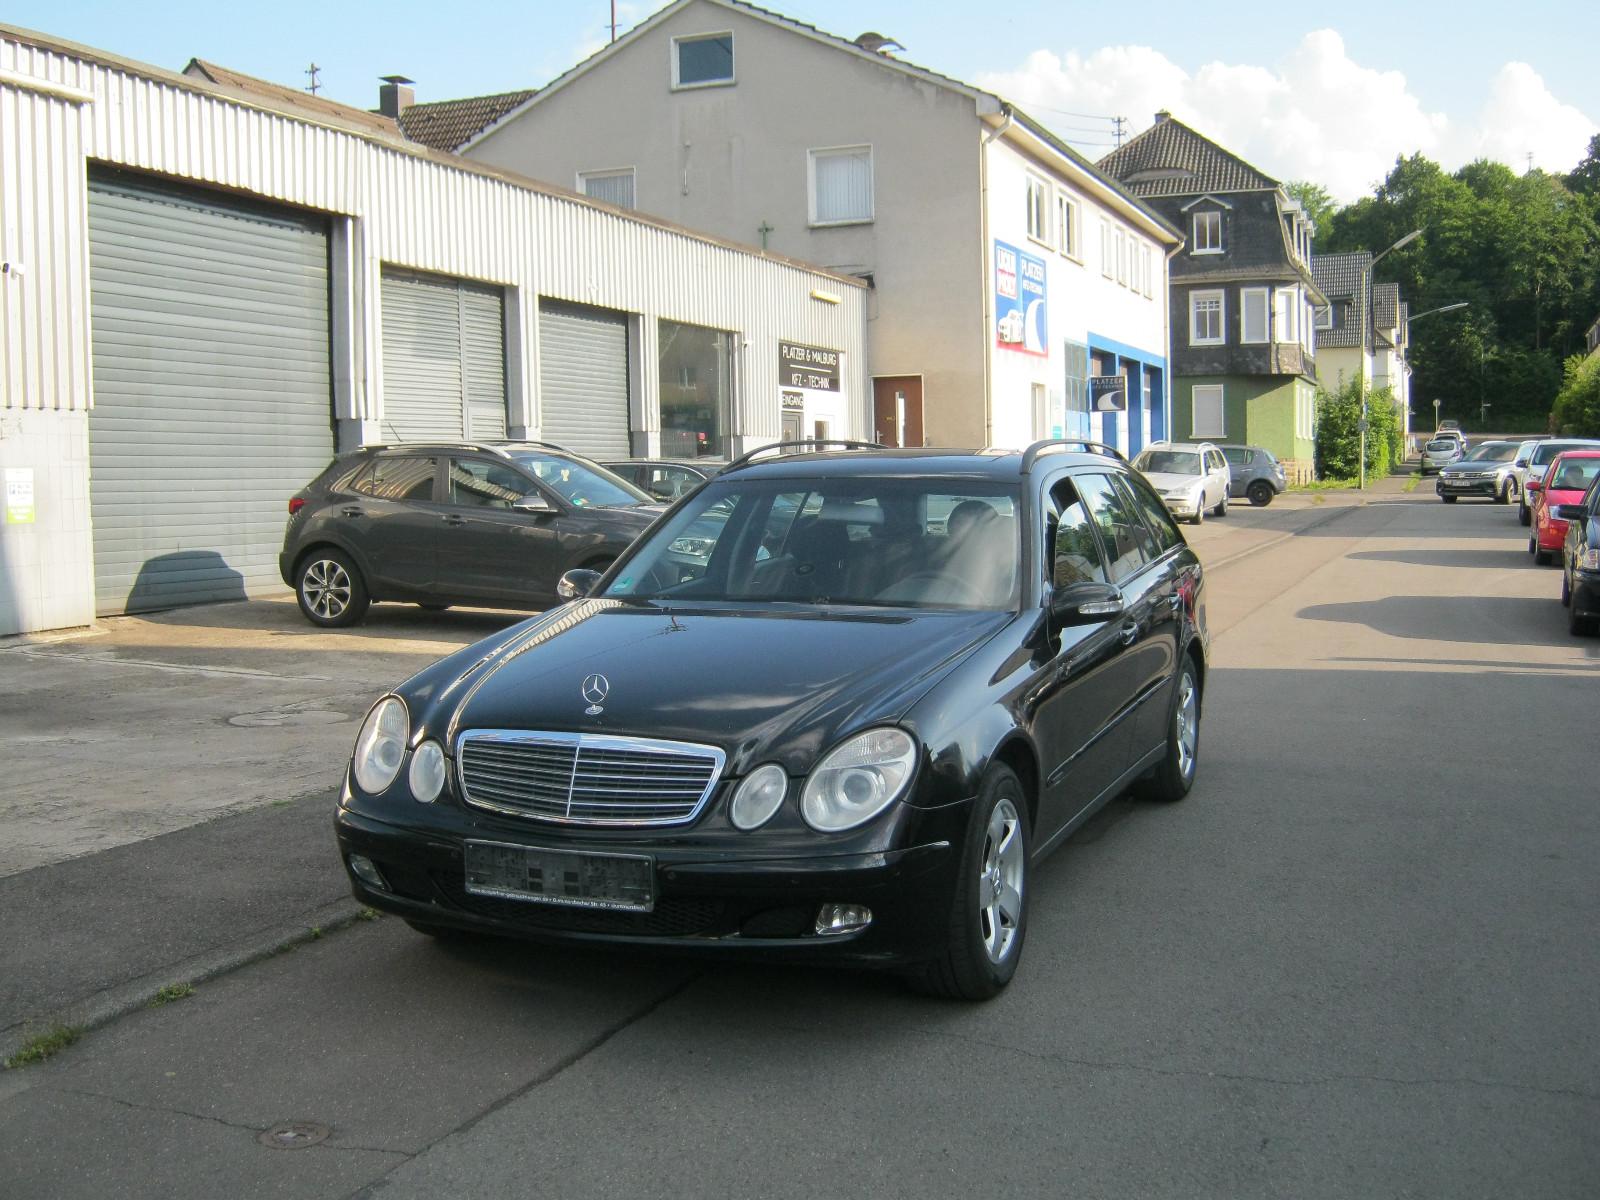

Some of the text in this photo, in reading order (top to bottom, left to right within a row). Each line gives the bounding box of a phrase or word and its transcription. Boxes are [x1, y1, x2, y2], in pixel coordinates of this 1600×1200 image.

[782, 345, 805, 361] PLATZER
[805, 350, 811, 362] &
[791, 373, 802, 386] KFZ
[807, 375, 830, 389] TECHNIK
[1091, 377, 1123, 385] PLATZER
[782, 394, 804, 407] EINGANG
